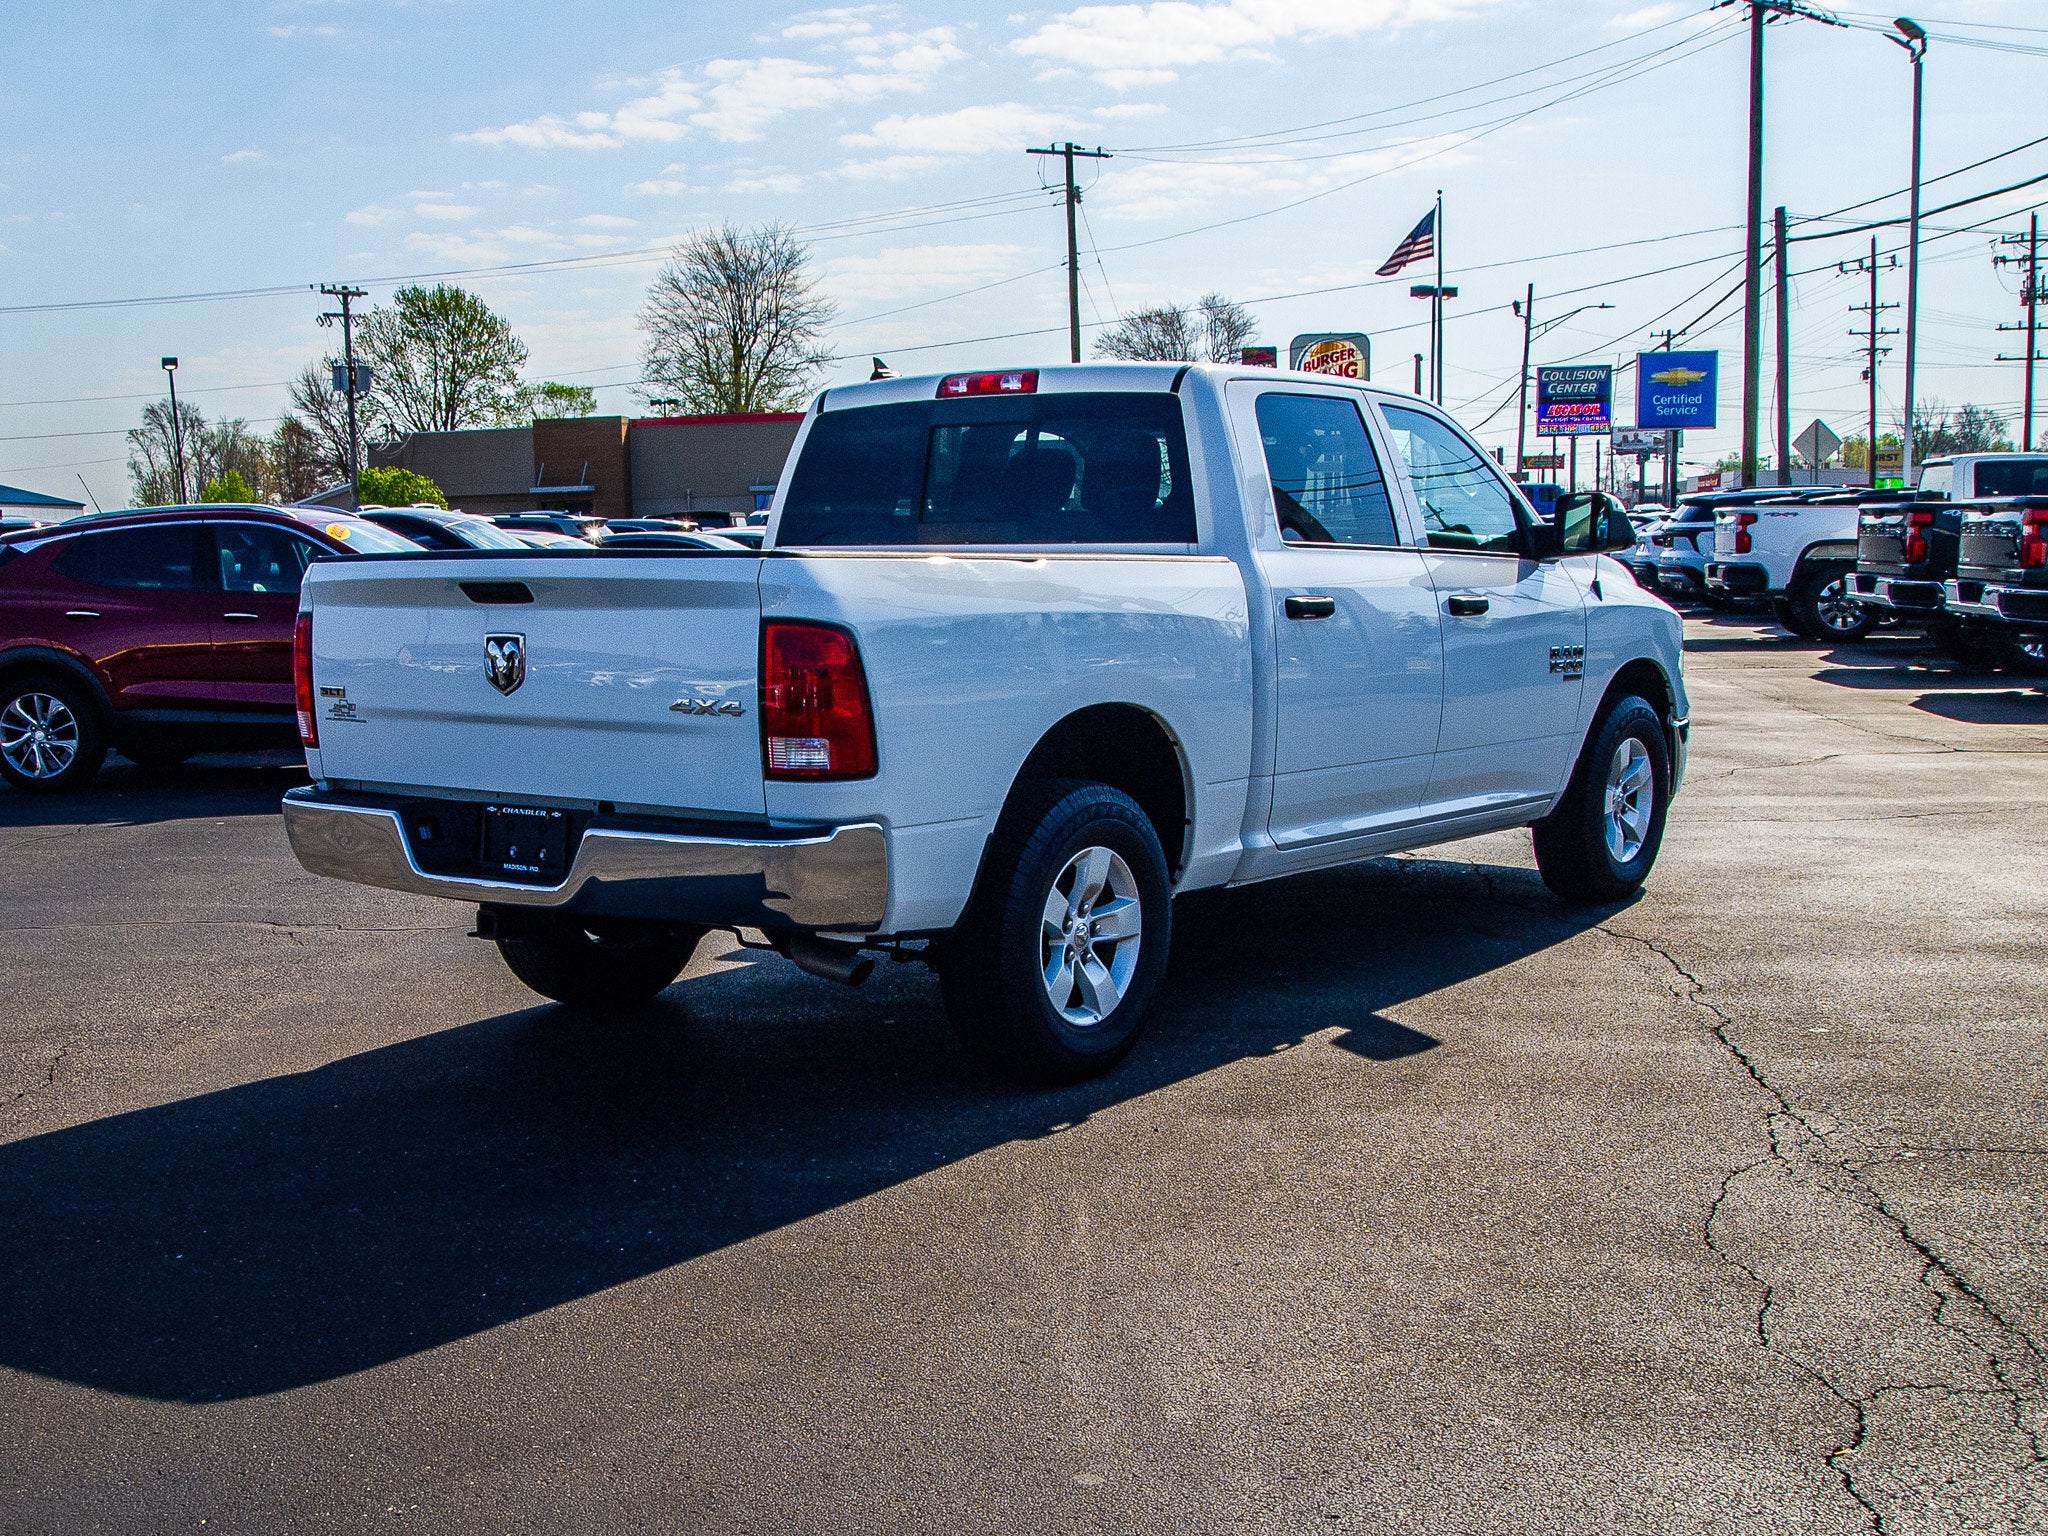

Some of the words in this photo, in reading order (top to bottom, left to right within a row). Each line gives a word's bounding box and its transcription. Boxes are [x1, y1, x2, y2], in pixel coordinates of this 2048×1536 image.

[1303, 348, 1355, 372] BURGER
[1541, 370, 1607, 381] COLLISION
[1547, 383, 1597, 394] CENTER
[1652, 394, 1703, 405] Certified
[1656, 405, 1698, 416] Service
[502, 807, 547, 817] CHANDLER
